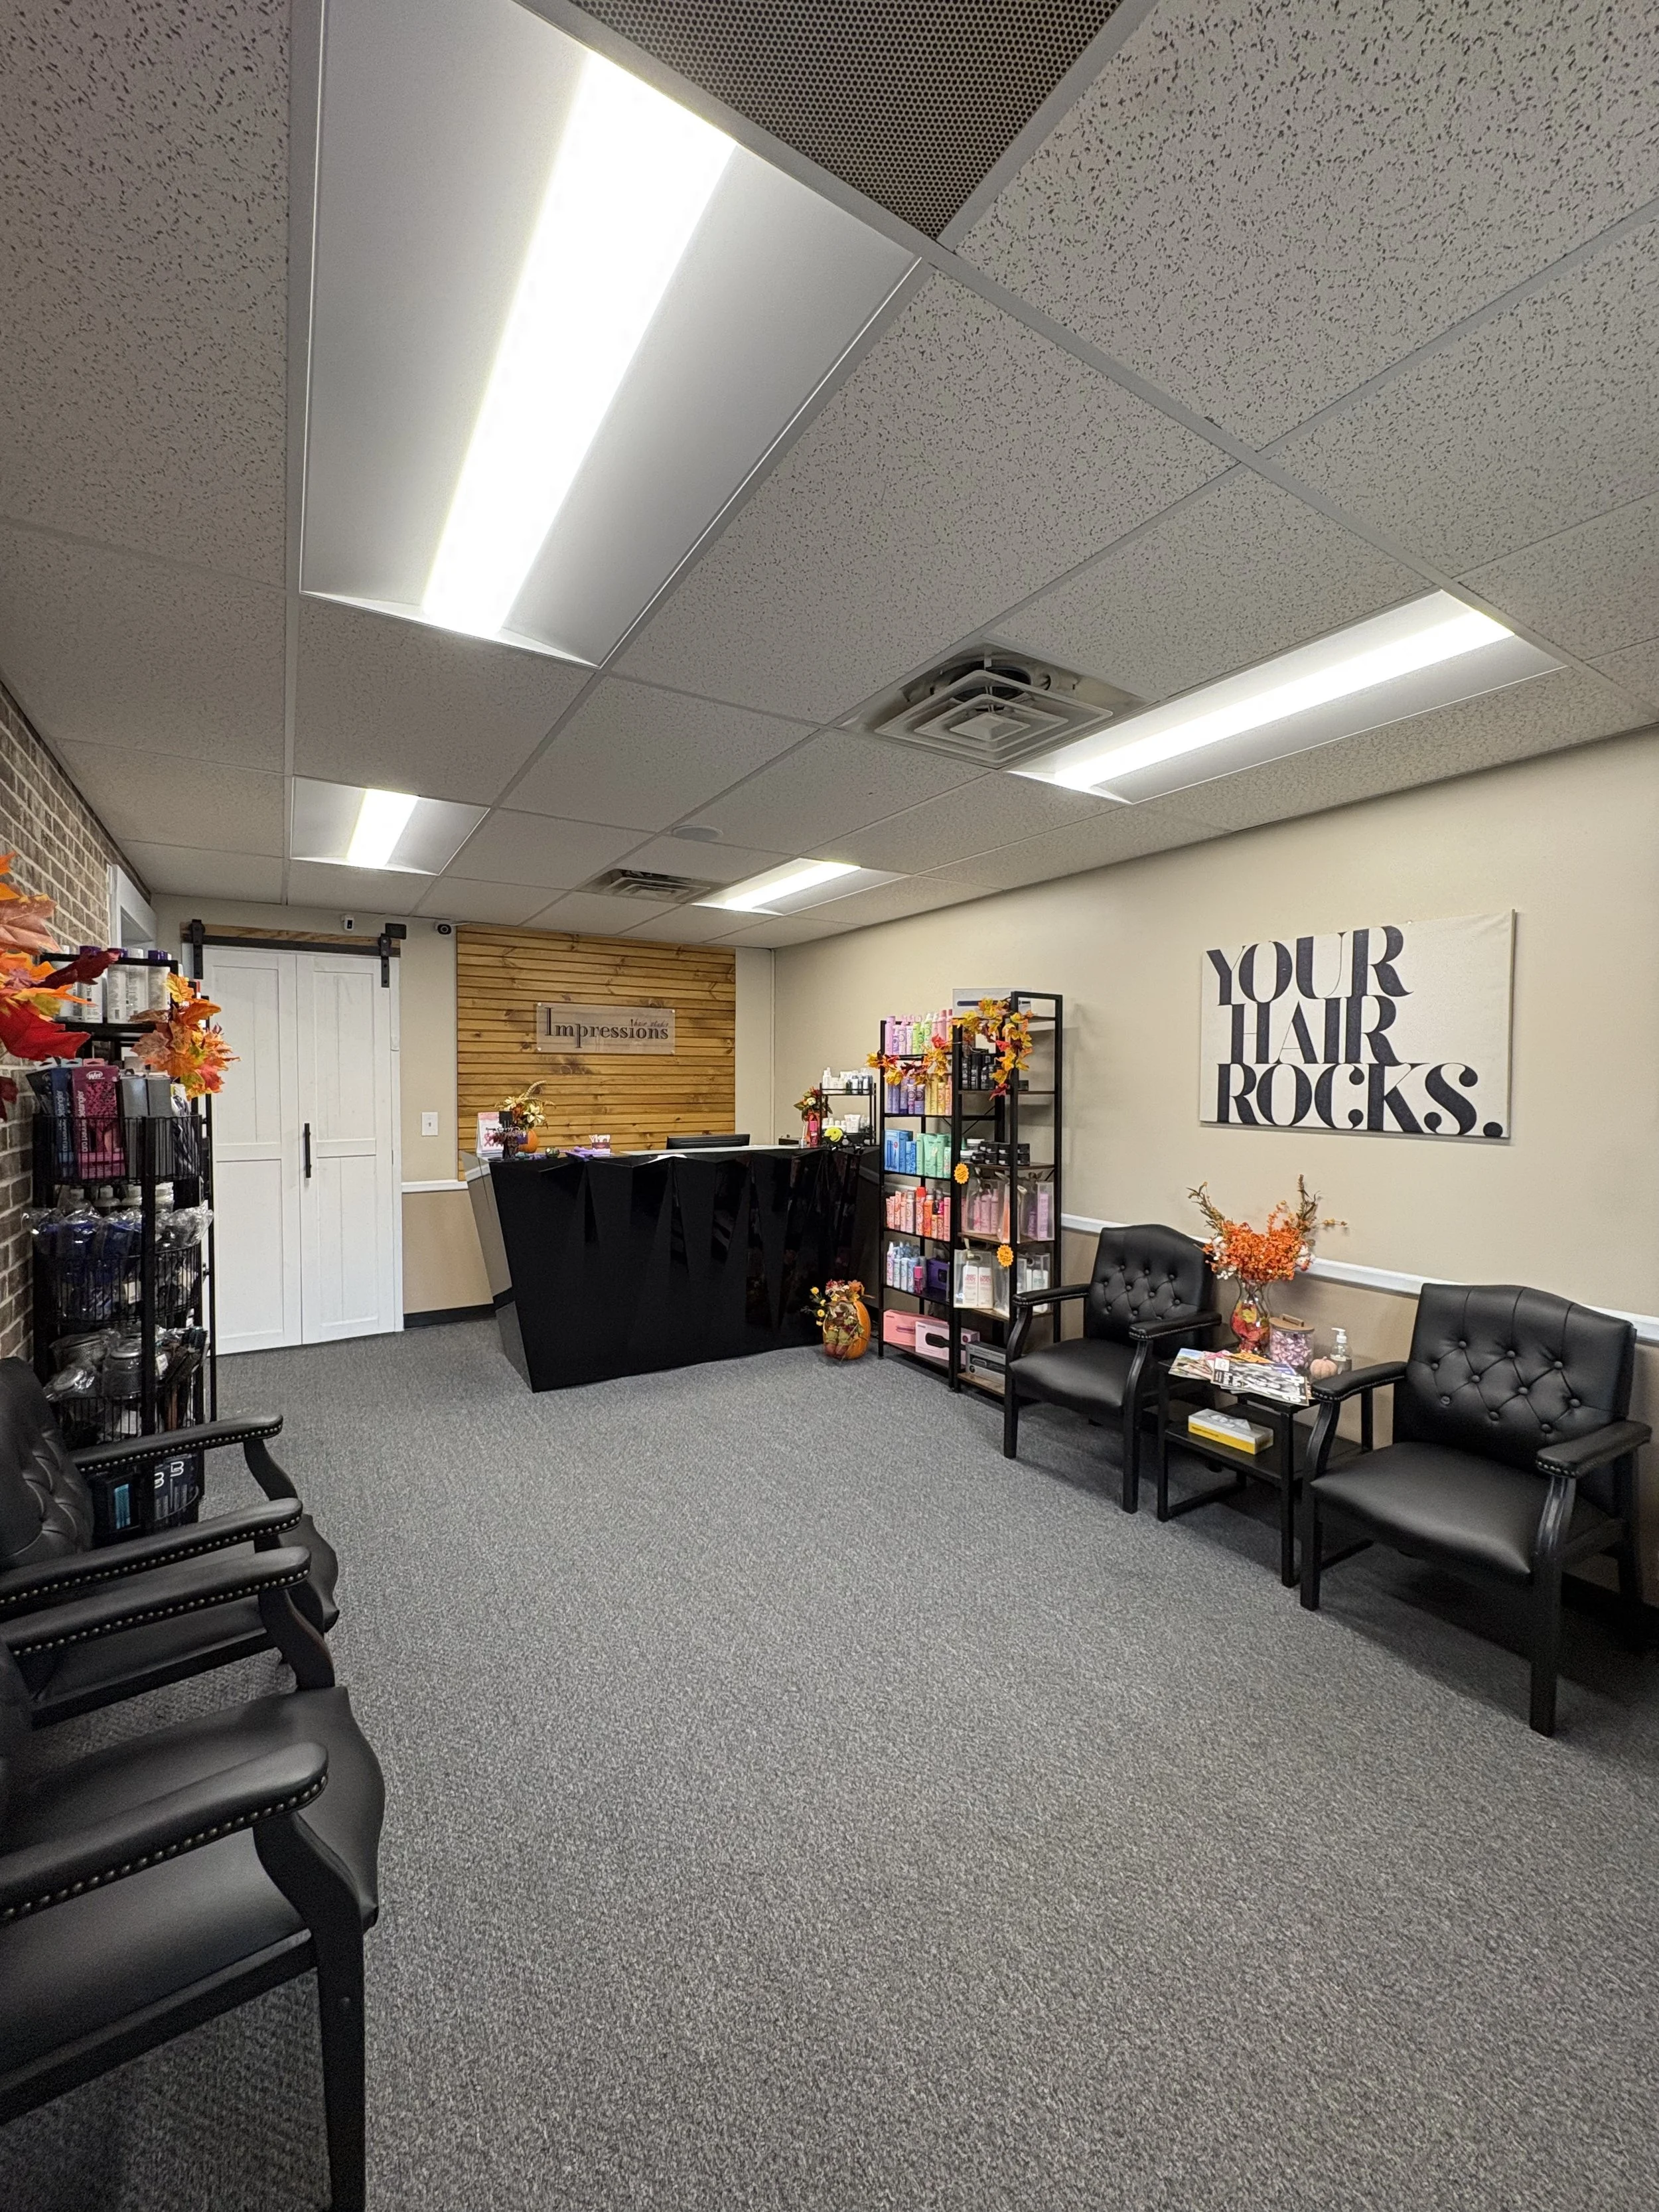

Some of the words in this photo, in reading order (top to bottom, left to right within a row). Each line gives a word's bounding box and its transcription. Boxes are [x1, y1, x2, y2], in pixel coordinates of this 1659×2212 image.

[1206, 926, 1414, 1005] YOUR
[545, 1007, 669, 1049] Impressions
[1221, 995, 1406, 1067] HAIR
[1217, 1063, 1504, 1138] ROCKS.
